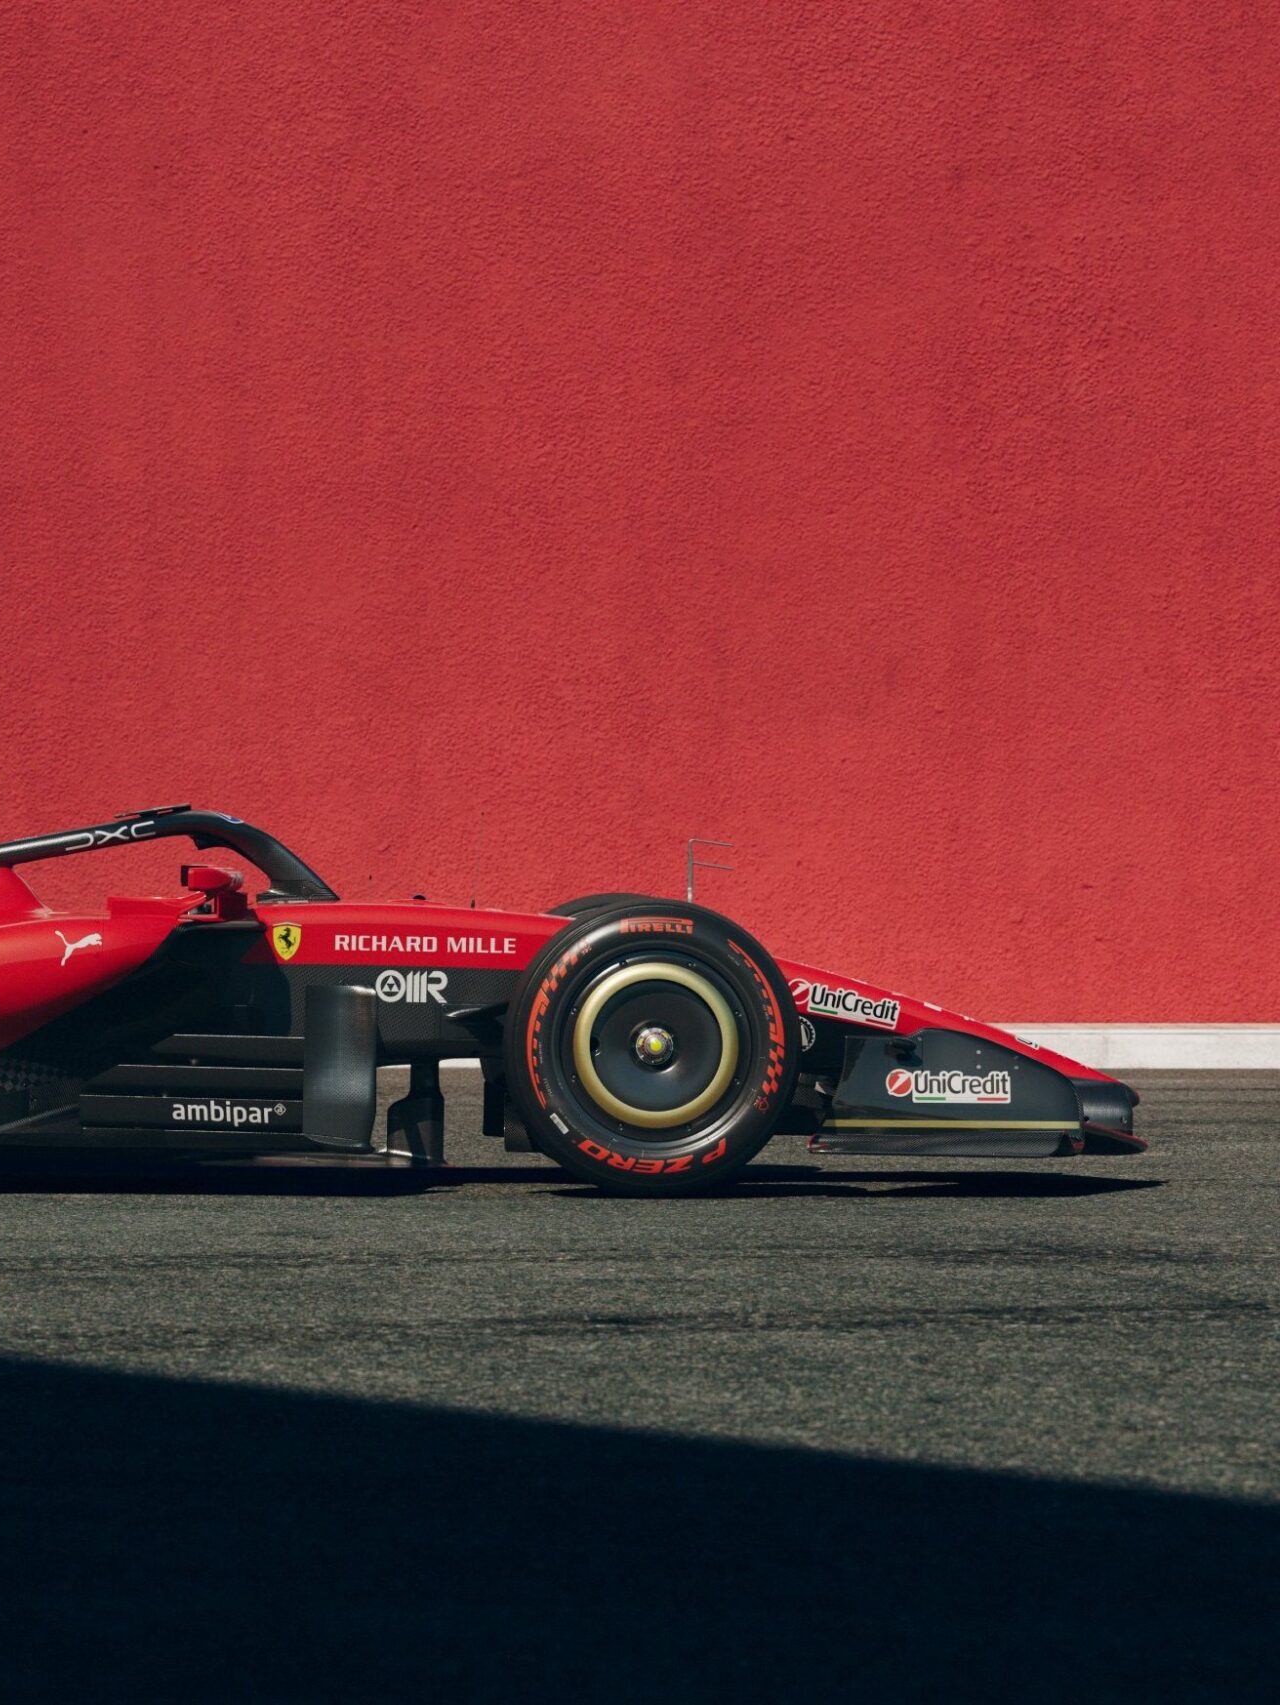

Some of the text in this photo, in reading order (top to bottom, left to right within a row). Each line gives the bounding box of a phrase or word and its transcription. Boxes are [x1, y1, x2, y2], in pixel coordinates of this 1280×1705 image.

[65, 820, 157, 851] DXC
[619, 916, 694, 935] PIRELLI
[334, 934, 516, 954] RICHARD MILLE
[811, 984, 900, 1022] UniCredit
[913, 1071, 1010, 1096] UniCredit
[172, 1101, 274, 1127] ambipar
[577, 1138, 696, 1175] ZERO
